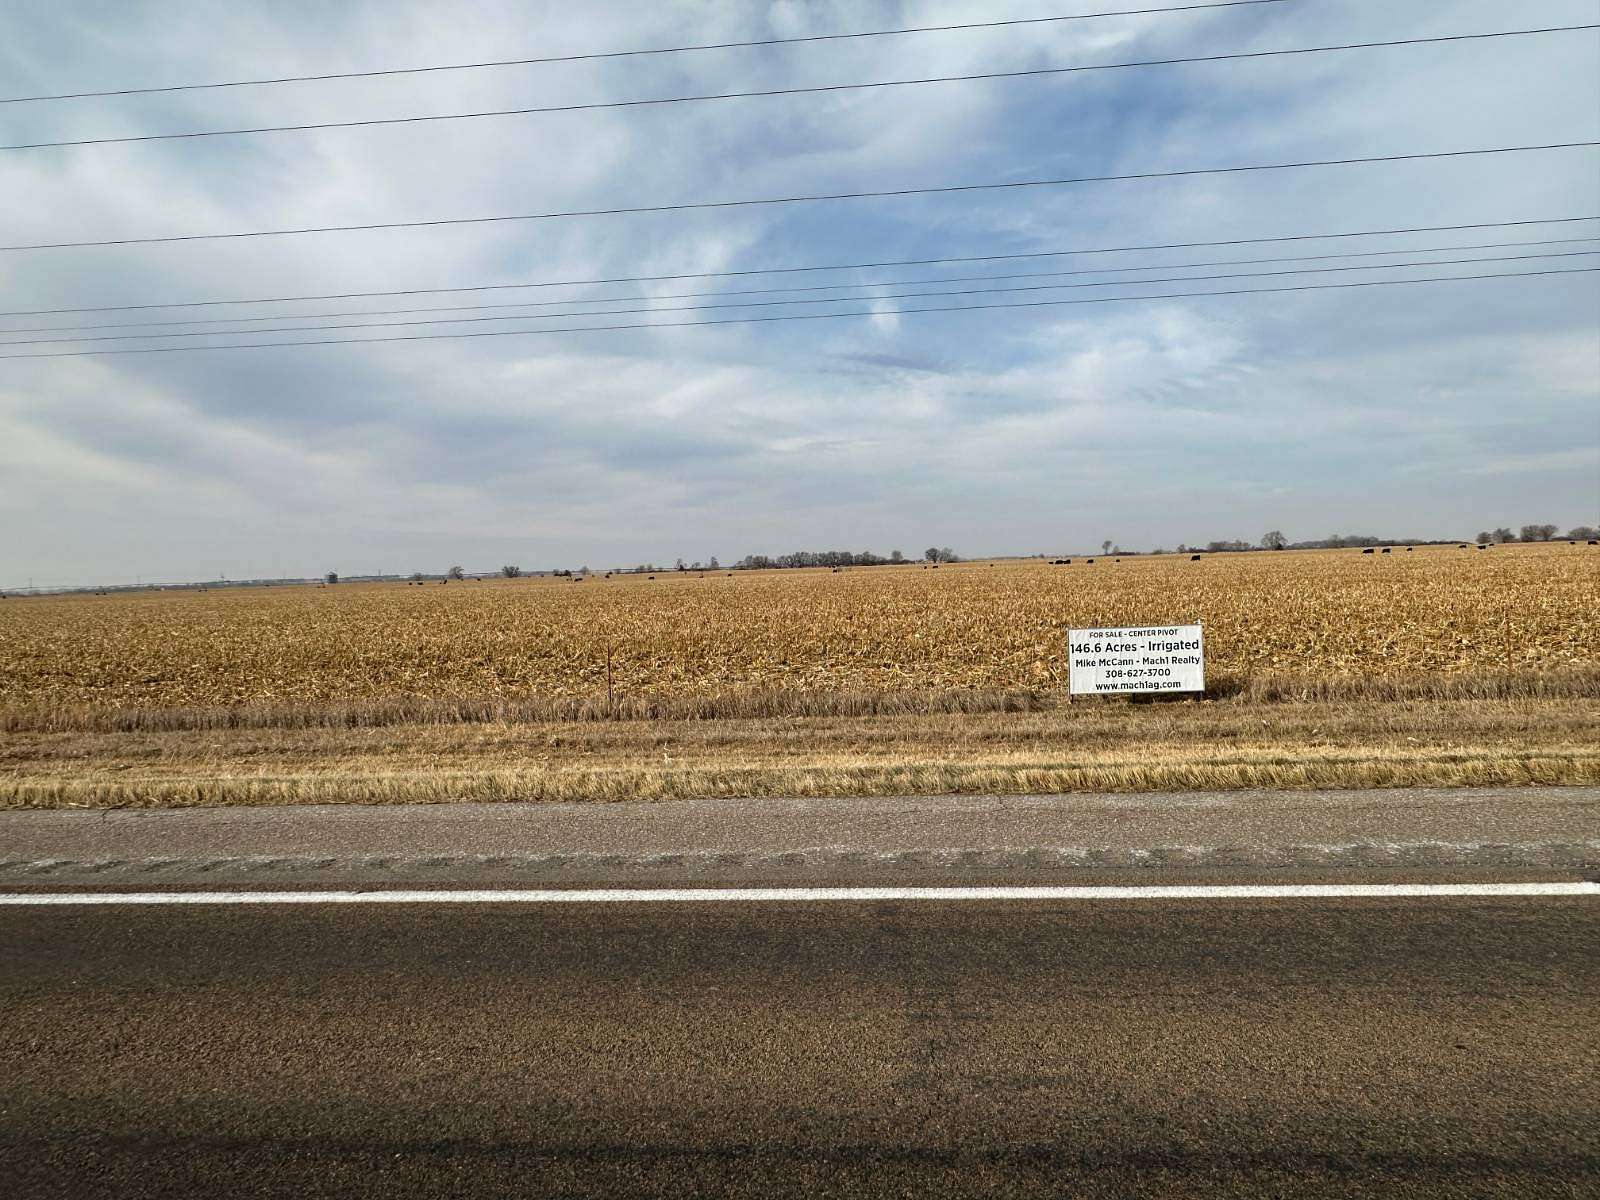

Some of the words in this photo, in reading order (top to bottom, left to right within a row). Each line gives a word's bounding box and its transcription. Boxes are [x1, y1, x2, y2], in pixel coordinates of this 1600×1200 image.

[1070, 643, 1101, 653] 146.6
[1105, 643, 1137, 652] Acres
[1148, 640, 1199, 652] Irrigated
[1076, 659, 1096, 667] Mike
[1099, 658, 1134, 667] McCann
[1143, 657, 1168, 665] Mach1
[1172, 656, 1200, 665] Realty
[1105, 669, 1170, 678] 308-627-3700
[1096, 681, 1181, 690] www.mach1ag.com
